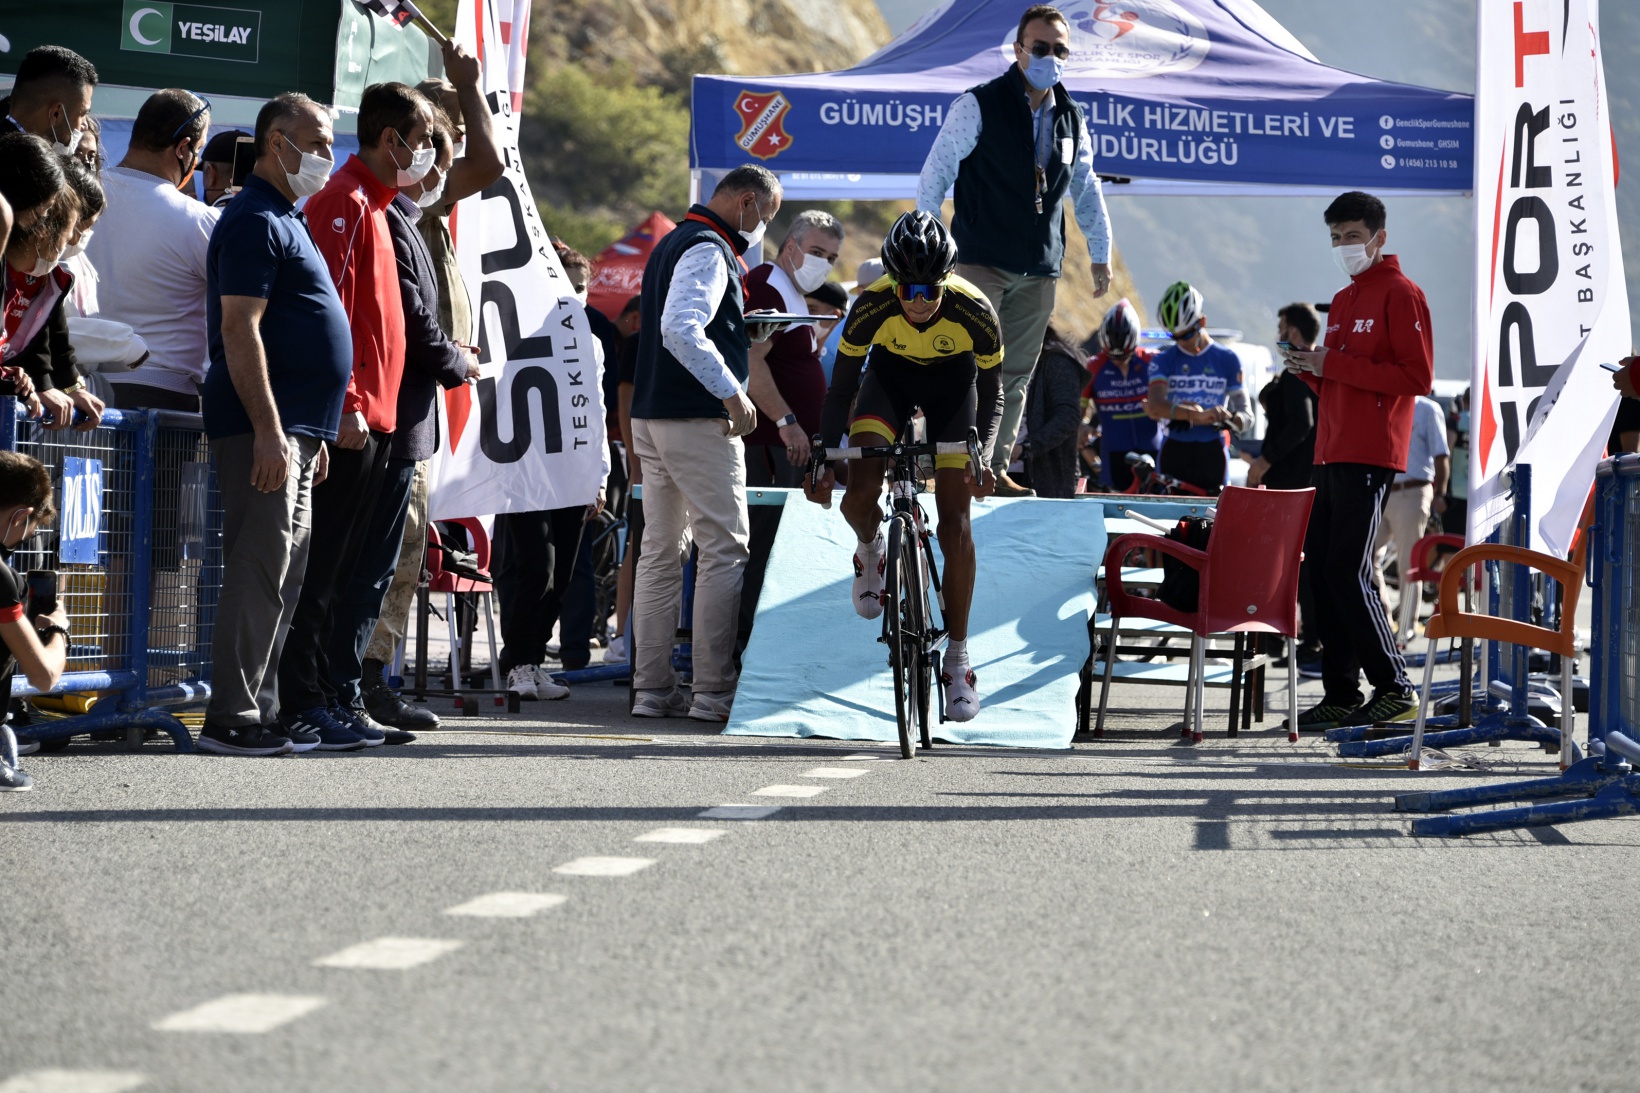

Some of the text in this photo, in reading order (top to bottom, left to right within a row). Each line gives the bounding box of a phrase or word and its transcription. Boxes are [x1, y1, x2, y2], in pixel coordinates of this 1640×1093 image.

[742, 99, 784, 148] GÜMÜŞHANE
[1144, 102, 1309, 137] HİZMETLERİ
[1317, 116, 1355, 138] VE
[1557, 98, 1594, 303] BAŞKANLIĞI
[557, 297, 589, 450] TEŞKİLAT
[62, 458, 101, 541] POLİS
